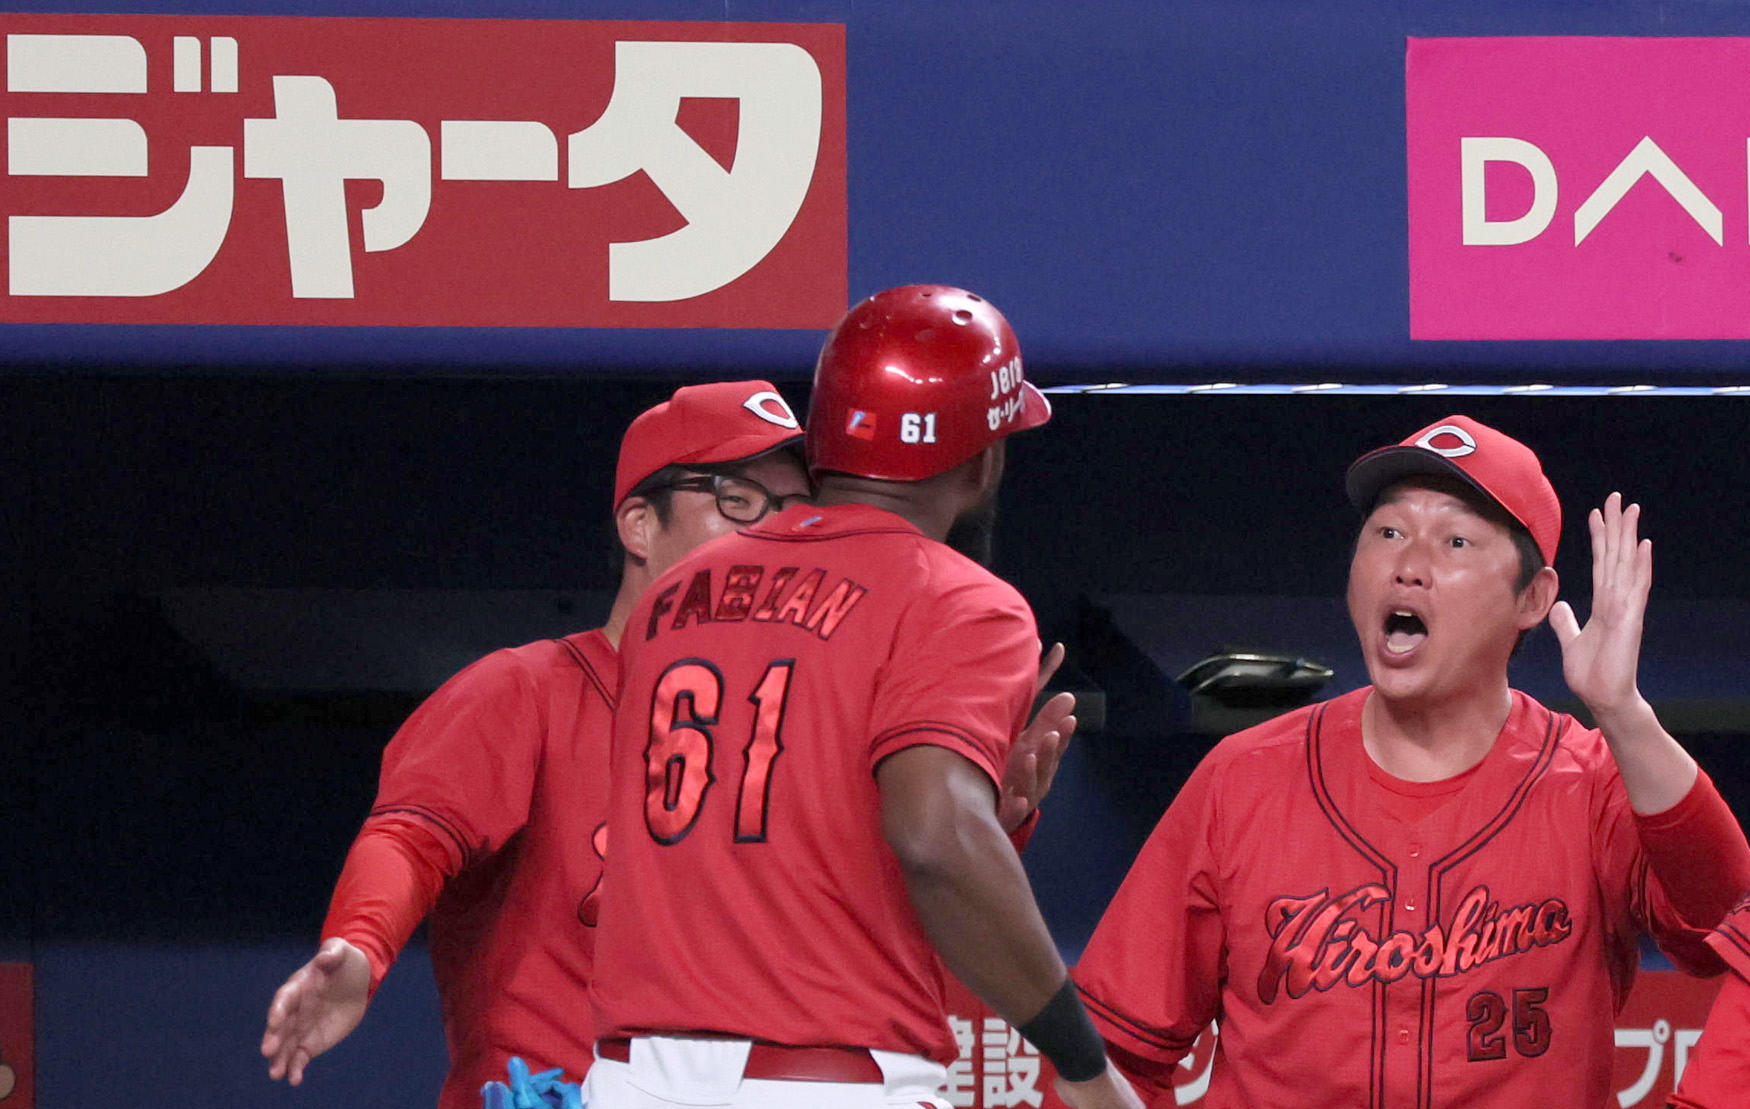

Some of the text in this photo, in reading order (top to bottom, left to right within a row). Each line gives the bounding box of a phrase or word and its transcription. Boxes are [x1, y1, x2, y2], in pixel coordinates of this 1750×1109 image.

[6, 34, 824, 302] ジャータ
[900, 411, 936, 443] 61
[645, 564, 868, 642] FABIAN
[643, 656, 797, 847] 61
[1256, 882, 1573, 1006] Hiroshima
[1465, 986, 1554, 1063] 25
